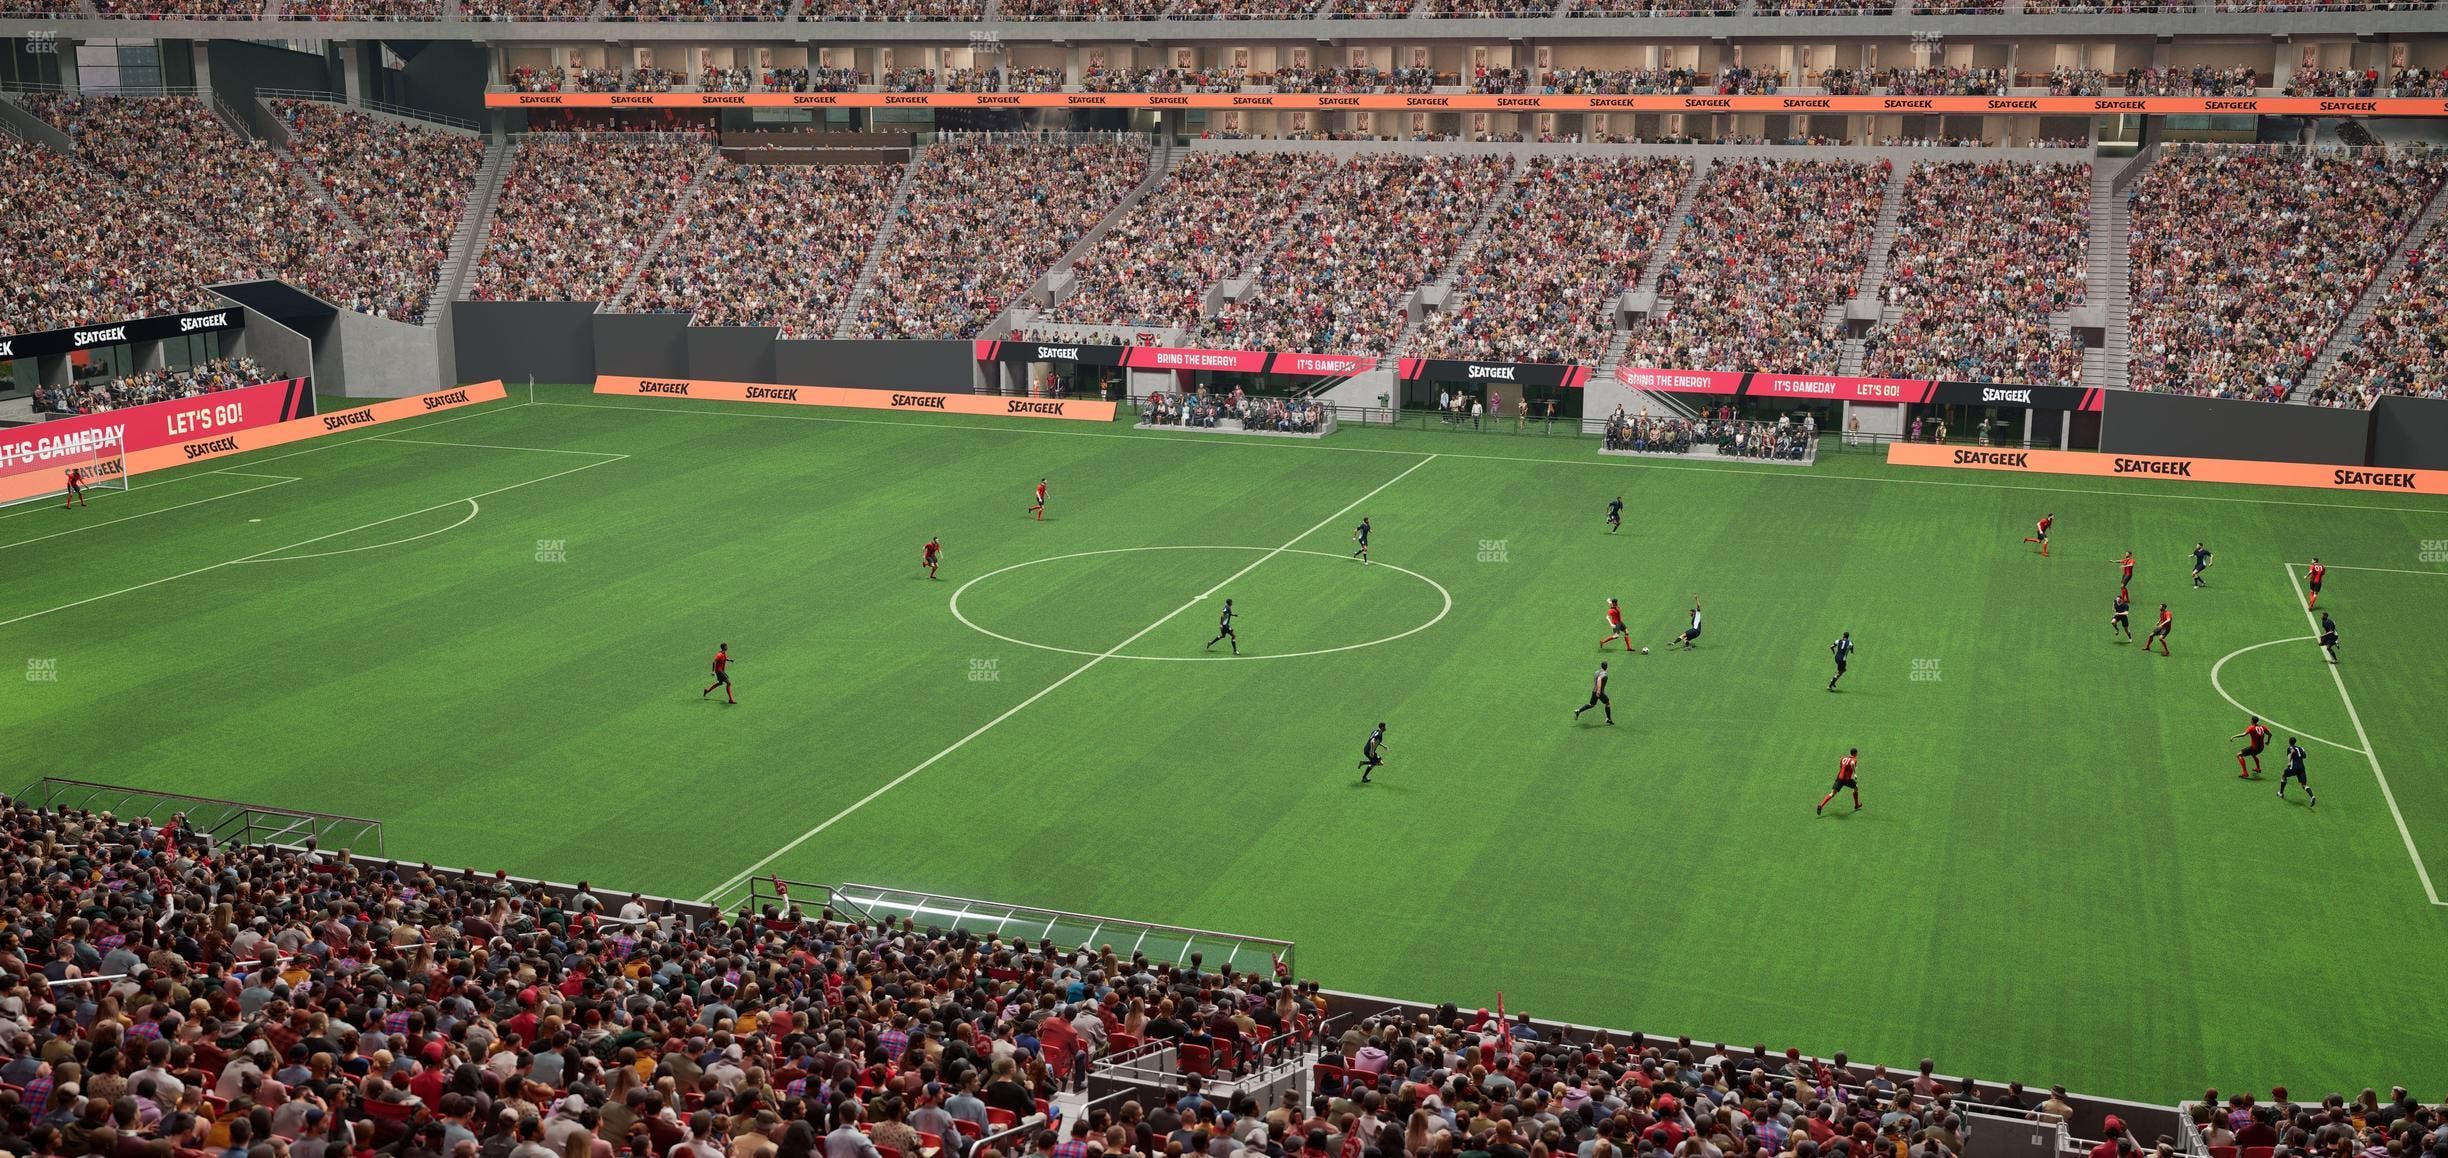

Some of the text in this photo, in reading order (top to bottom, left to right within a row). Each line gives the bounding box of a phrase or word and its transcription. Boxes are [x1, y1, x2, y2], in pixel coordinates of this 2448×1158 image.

[1498, 98, 1540, 106] SEATGEEK
[1590, 99, 1633, 107] SEATGEEK
[1685, 99, 1730, 107] SEATGEEK
[1885, 100, 1932, 108] SEATGEEK
[1988, 100, 2037, 108] SEATGEEK
[2095, 101, 2145, 109] SEATGEEK
[2205, 101, 2257, 110] SEATGEEK
[2320, 102, 2376, 111] SEATGEEK
[181, 310, 227, 331] SEATGEEK
[74, 325, 126, 346] SEATGEEK
[1038, 346, 1079, 360] SEATGEEK
[1157, 353, 1237, 367] BRING THE ENERGY!
[1297, 359, 1313, 370] IT'S
[1468, 364, 1514, 380] SEATGEEK
[639, 380, 689, 395] SEATGEEK
[1656, 375, 1673, 386] THE
[1674, 376, 1711, 388] ENERGY!
[1774, 381, 1836, 394] IT'S GAMEDAY
[746, 386, 797, 401] SEATGEEK
[1857, 384, 1900, 396] LET'S GO!
[1982, 387, 2031, 404] SEATGEEK
[423, 390, 469, 410] SEATGEEK
[892, 393, 945, 409] SEATGEEK
[1008, 399, 1063, 416] SEATGEEK
[168, 403, 244, 436] LET'S GO!
[323, 409, 375, 430] SEATGEEK
[38, 424, 125, 460] GAMEDAY
[184, 436, 239, 459] SEATGEEK
[1953, 449, 2028, 468] SEATGEEK
[2114, 457, 2191, 477] SEATGEEK
[2334, 469, 2416, 489] SEATGEEK
